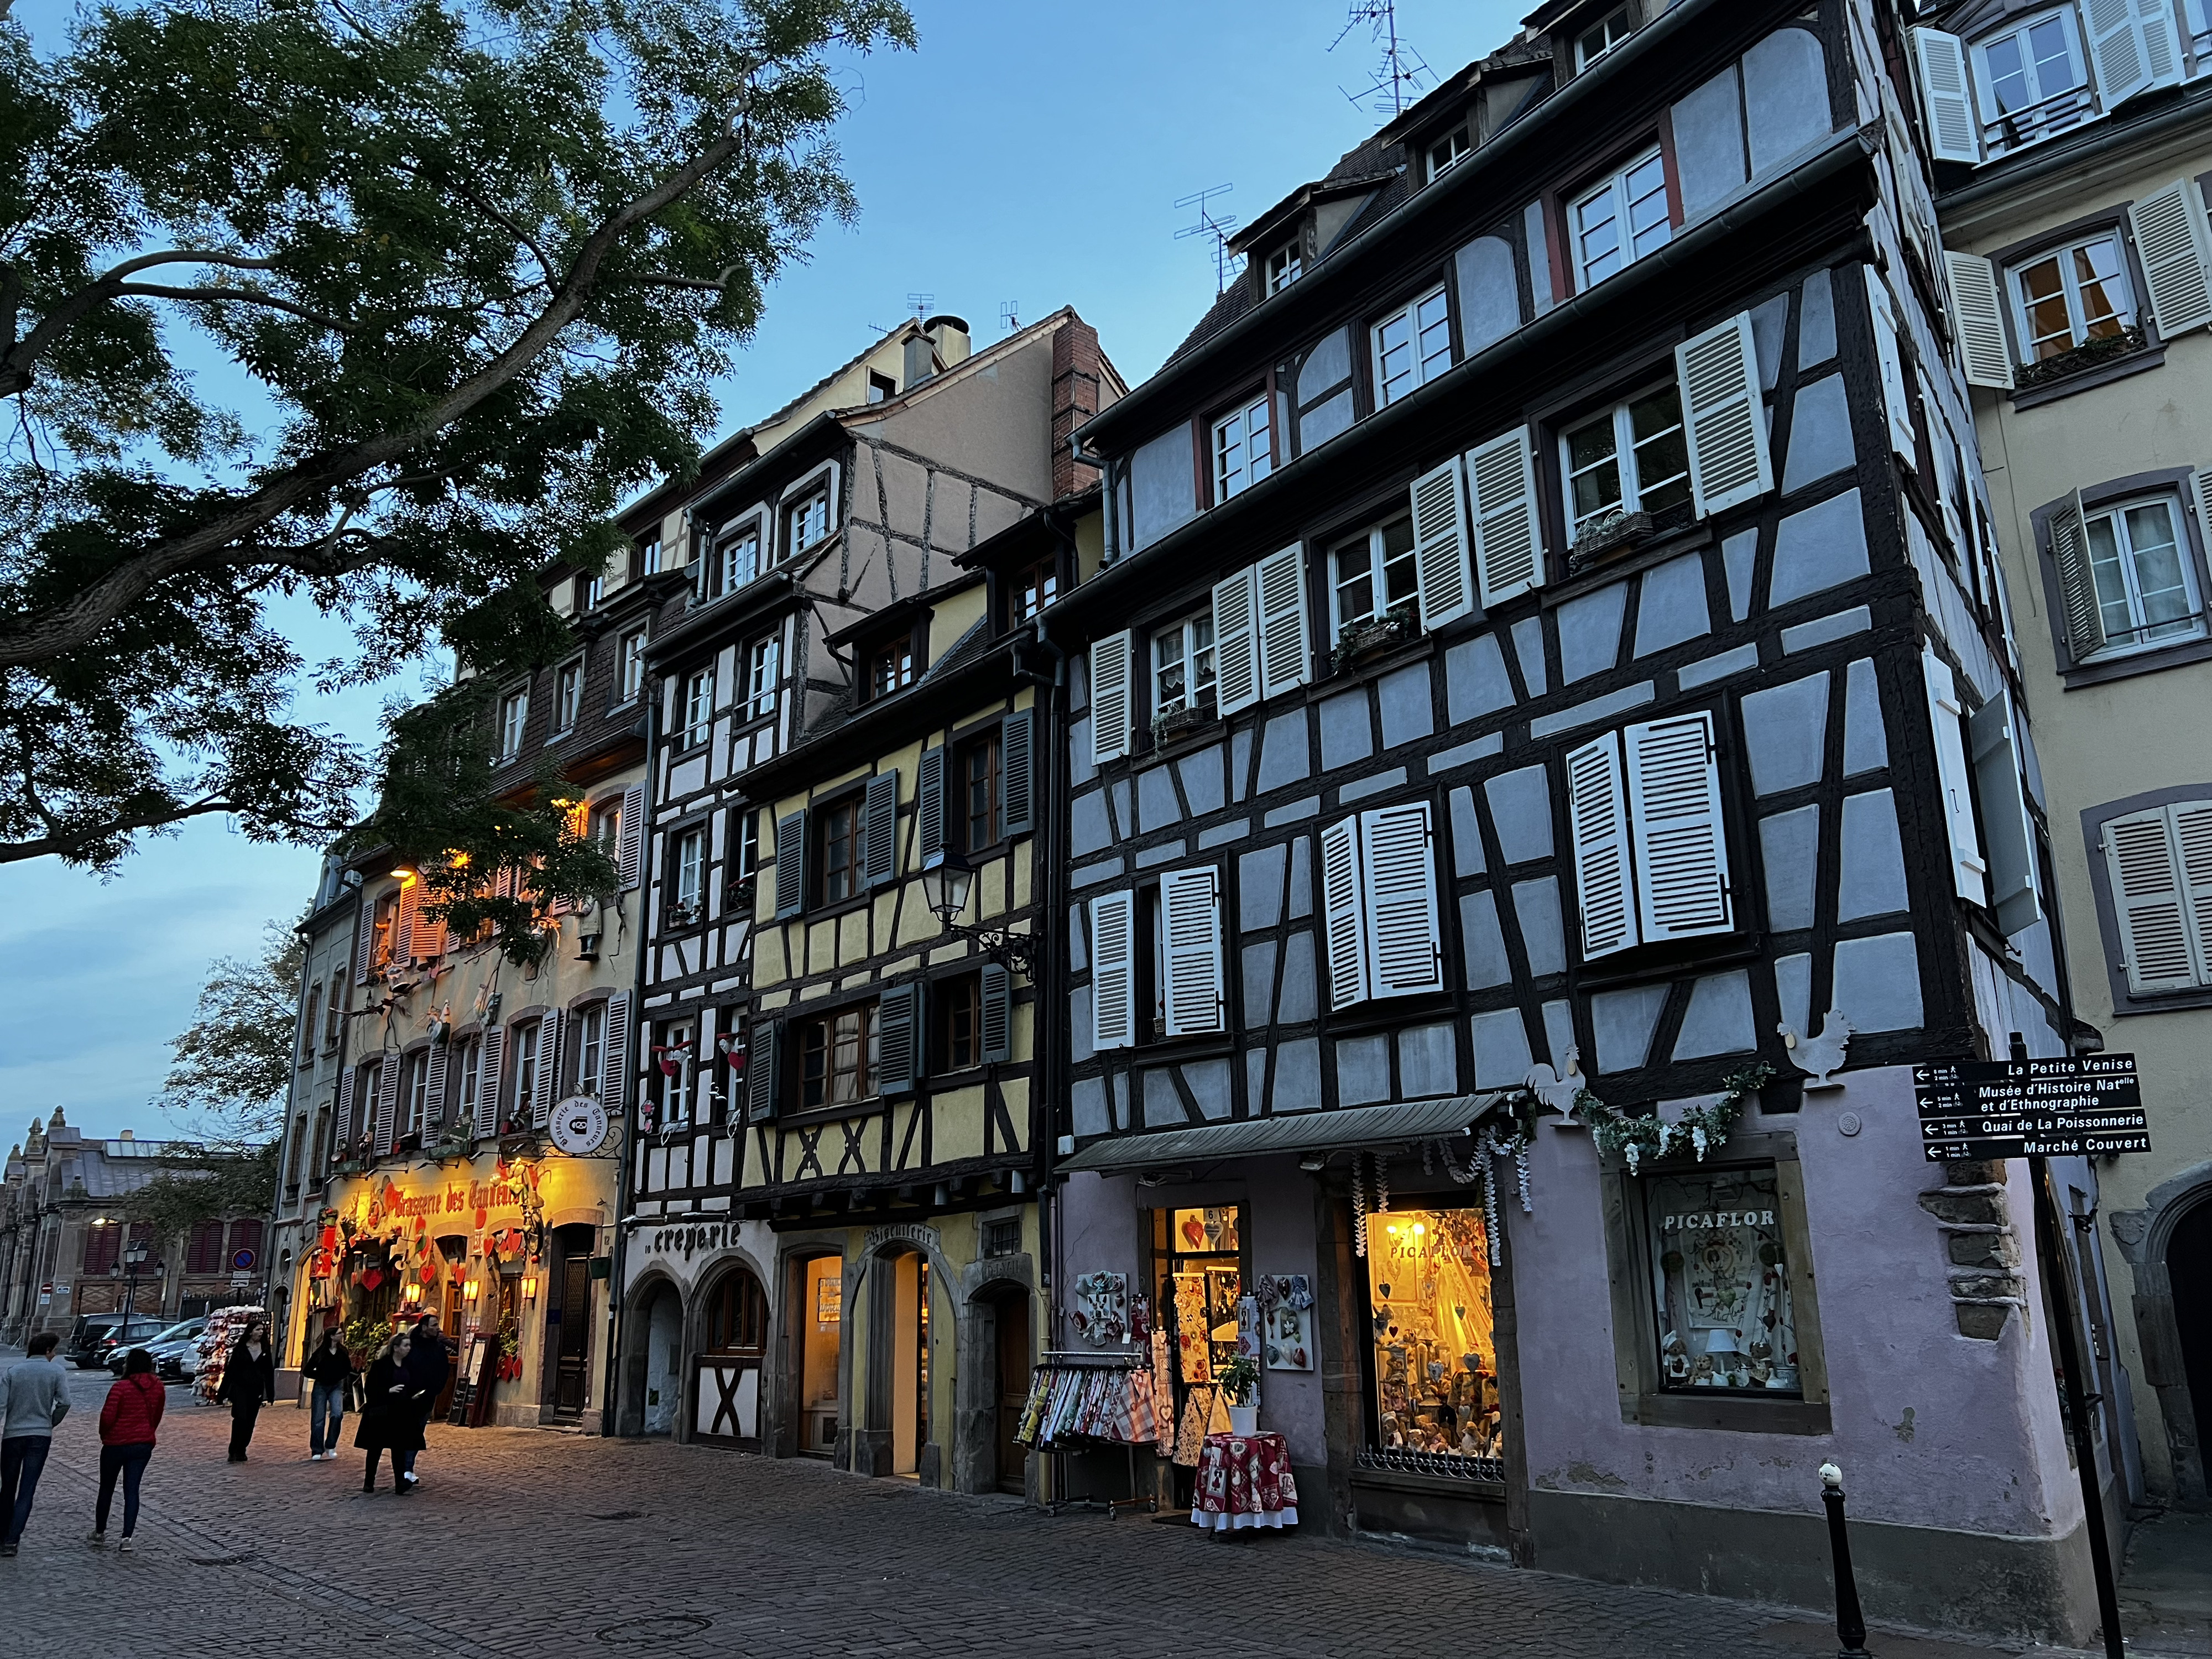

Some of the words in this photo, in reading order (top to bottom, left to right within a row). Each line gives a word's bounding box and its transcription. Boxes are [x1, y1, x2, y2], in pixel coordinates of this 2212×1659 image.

[2008, 1065, 2023, 1076] La
[2030, 1062, 2075, 1074] Petite
[2083, 1060, 2132, 1071] Venise
[1979, 1084, 2021, 1098] Musée
[2026, 1082, 2091, 1095] d'Histoire
[1981, 1102, 1994, 1112] et
[1999, 1095, 2099, 1111] d'Ethnographie
[1983, 1120, 2012, 1133] Quai
[2017, 1120, 2032, 1131] de
[2038, 1119, 2052, 1130] La
[2057, 1114, 2144, 1129] Poissonnerie
[2024, 1139, 2078, 1154] Marché
[2086, 1137, 2147, 1150] Couvert
[446, 1181, 465, 1213] des
[1208, 1210, 1213, 1219] 6
[1664, 1210, 1775, 1230] PICAFLOR
[869, 1224, 932, 1245] Biscuiterie
